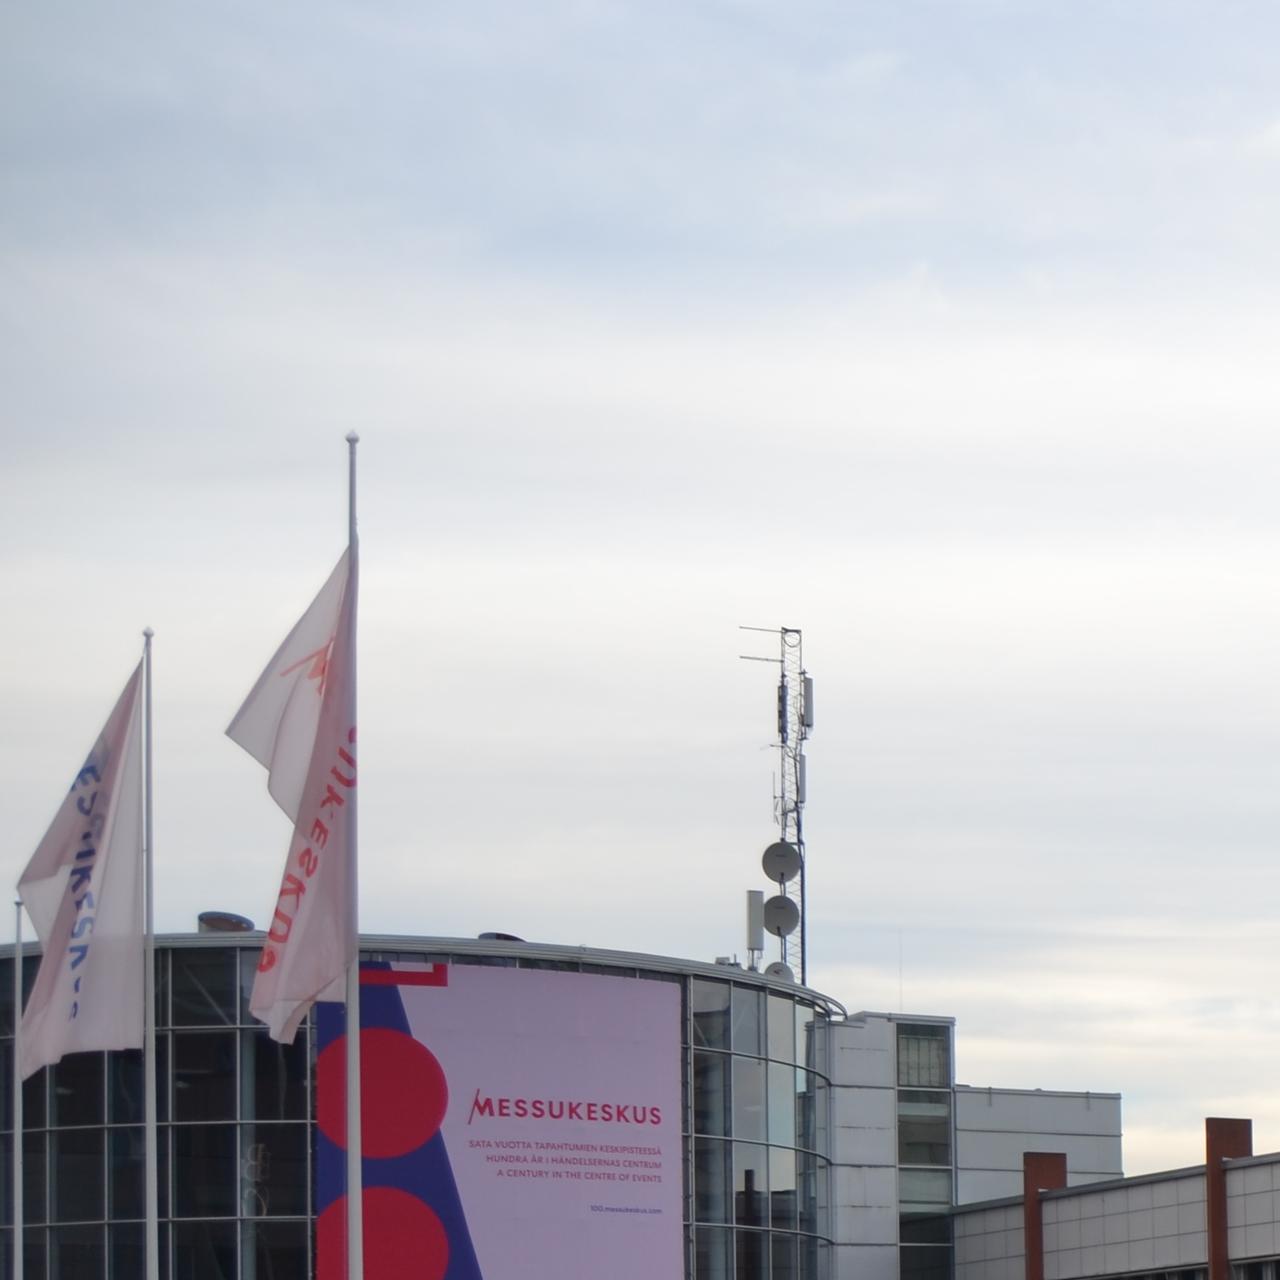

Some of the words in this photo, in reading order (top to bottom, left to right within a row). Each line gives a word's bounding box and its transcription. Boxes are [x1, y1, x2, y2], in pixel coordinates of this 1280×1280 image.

[467, 1088, 662, 1126] MESSUKESKUS
[468, 1139, 493, 1149] SATA
[494, 1140, 532, 1150] VUOTTA
[535, 1141, 598, 1153] TAPAHTUMIEN
[486, 1154, 528, 1164] HUNDRA
[622, 1159, 662, 1169] CENTRUM
[506, 1169, 549, 1178] CENTURY
[552, 1170, 562, 1179] IN
[565, 1171, 581, 1180] THE
[584, 1171, 616, 1181] CENTRE
[618, 1173, 630, 1182] OF
[632, 1174, 662, 1183] EVENTS
